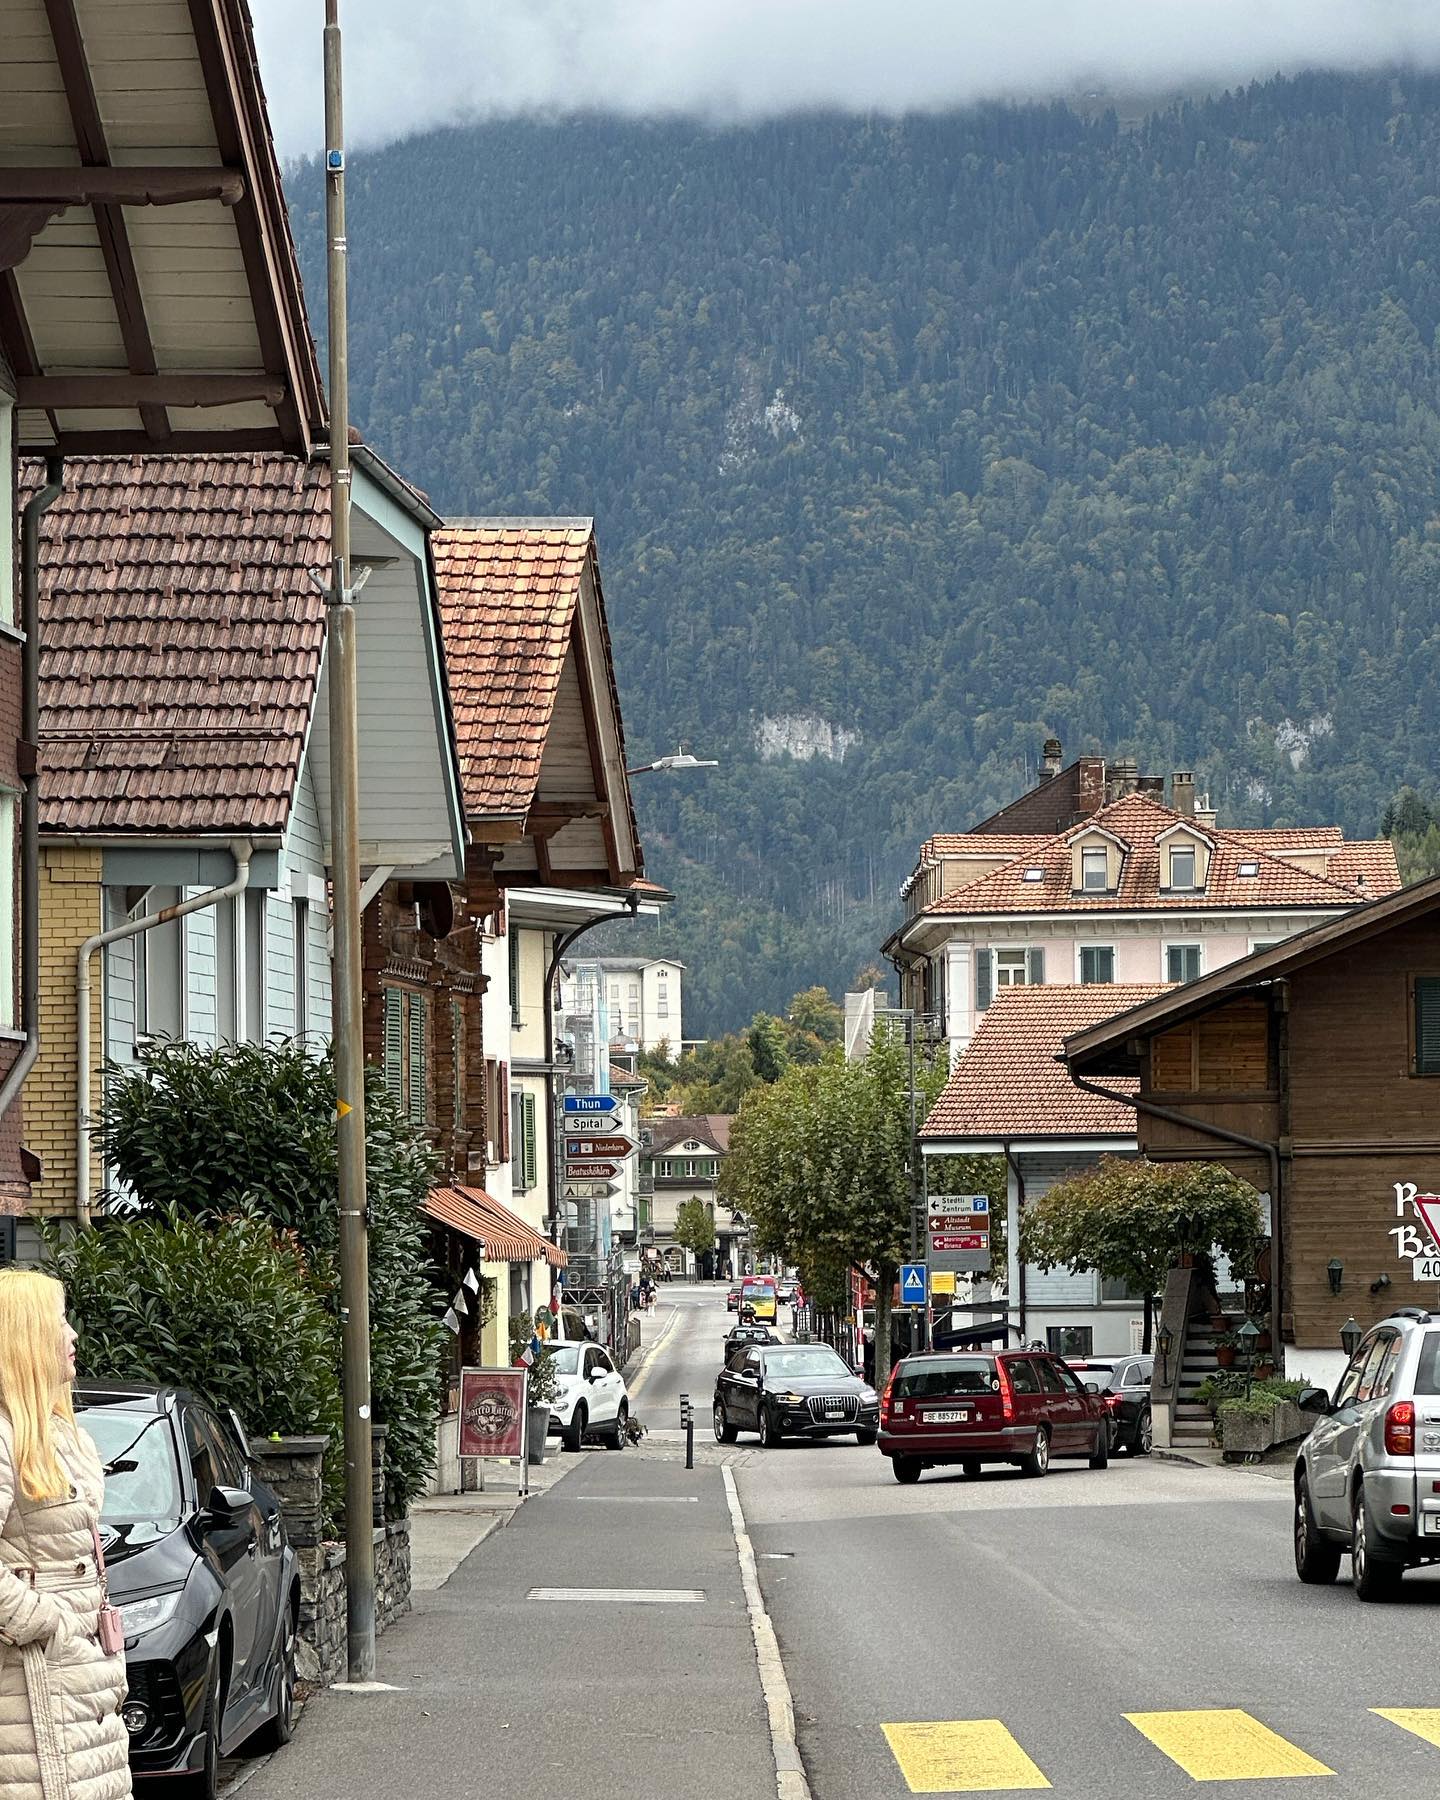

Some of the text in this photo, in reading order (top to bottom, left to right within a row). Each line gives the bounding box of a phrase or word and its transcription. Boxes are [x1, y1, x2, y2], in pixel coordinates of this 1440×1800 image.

[575, 1099, 601, 1109] Thun
[573, 1119, 603, 1131] Spital
[595, 1143, 624, 1151] Niederhorn
[977, 1202, 984, 1210] P
[944, 1216, 970, 1224] Altstadt
[944, 1223, 972, 1231] Museum
